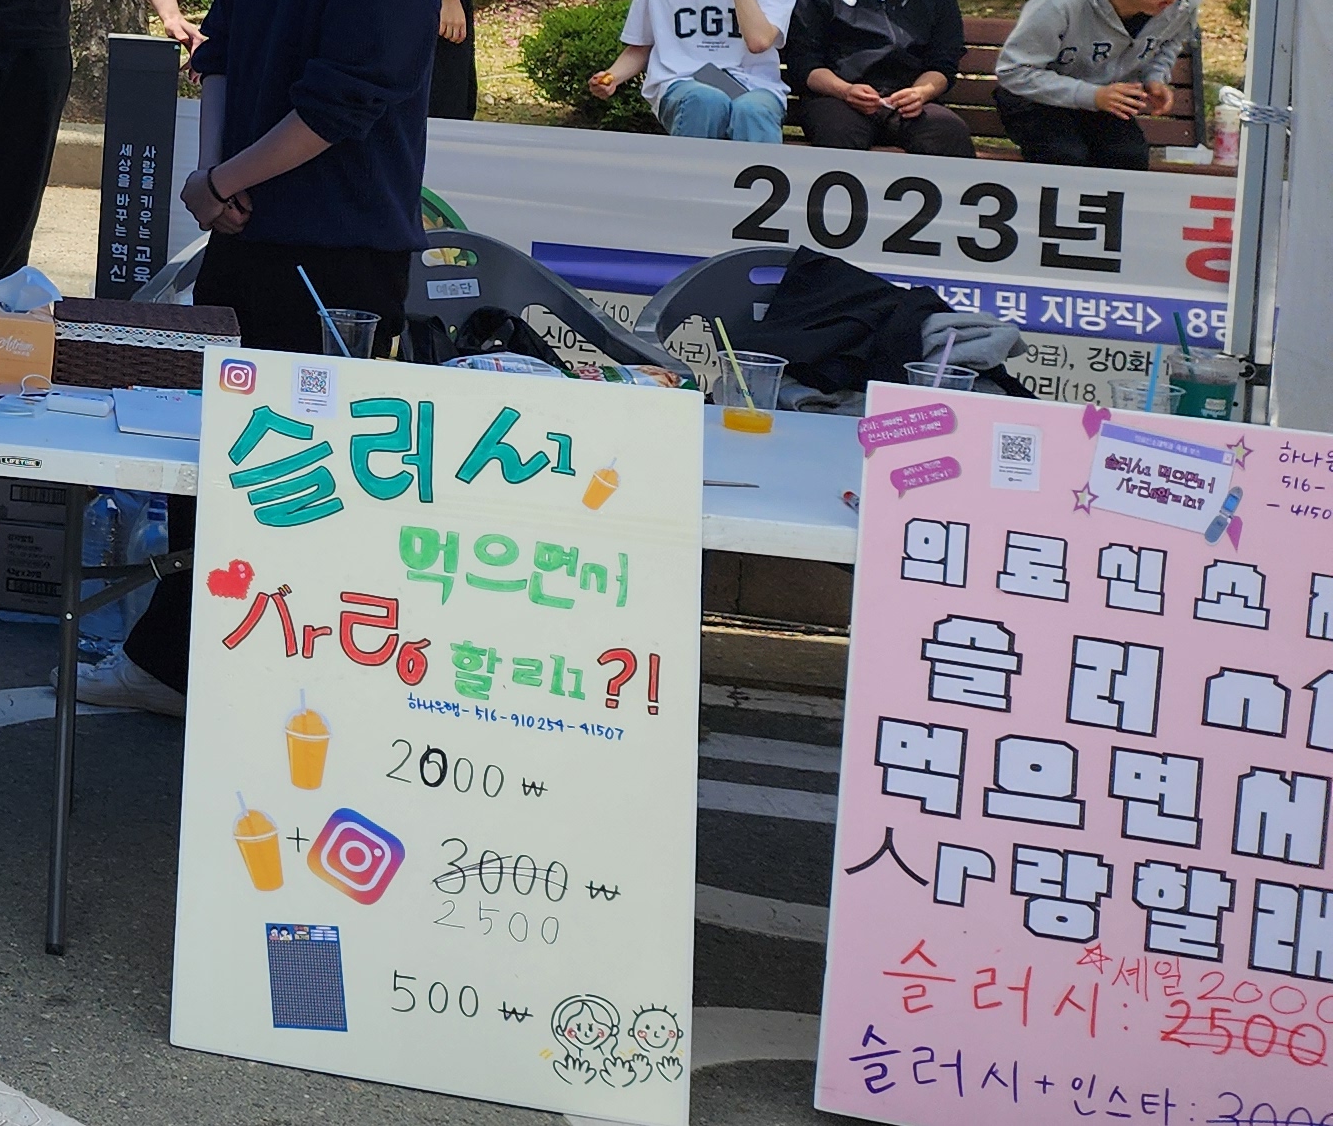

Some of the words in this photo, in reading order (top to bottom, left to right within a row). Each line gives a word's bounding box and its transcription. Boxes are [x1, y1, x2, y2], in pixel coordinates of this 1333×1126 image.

[117, 143, 133, 188] 세상을
[141, 145, 157, 190] 사람을
[114, 193, 130, 237] 바꾸는
[138, 195, 154, 239] 키우는
[732, 165, 1125, 273] 2023년
[109, 241, 129, 283] 혁신
[995, 292, 1027, 324] 및
[1041, 296, 1162, 333] 지방직>
[1020, 374, 1102, 406] 0리(18,
[874, 716, 1333, 870] 먹으면서
[432, 899, 561, 946] 2500
[391, 969, 480, 1020] 500
